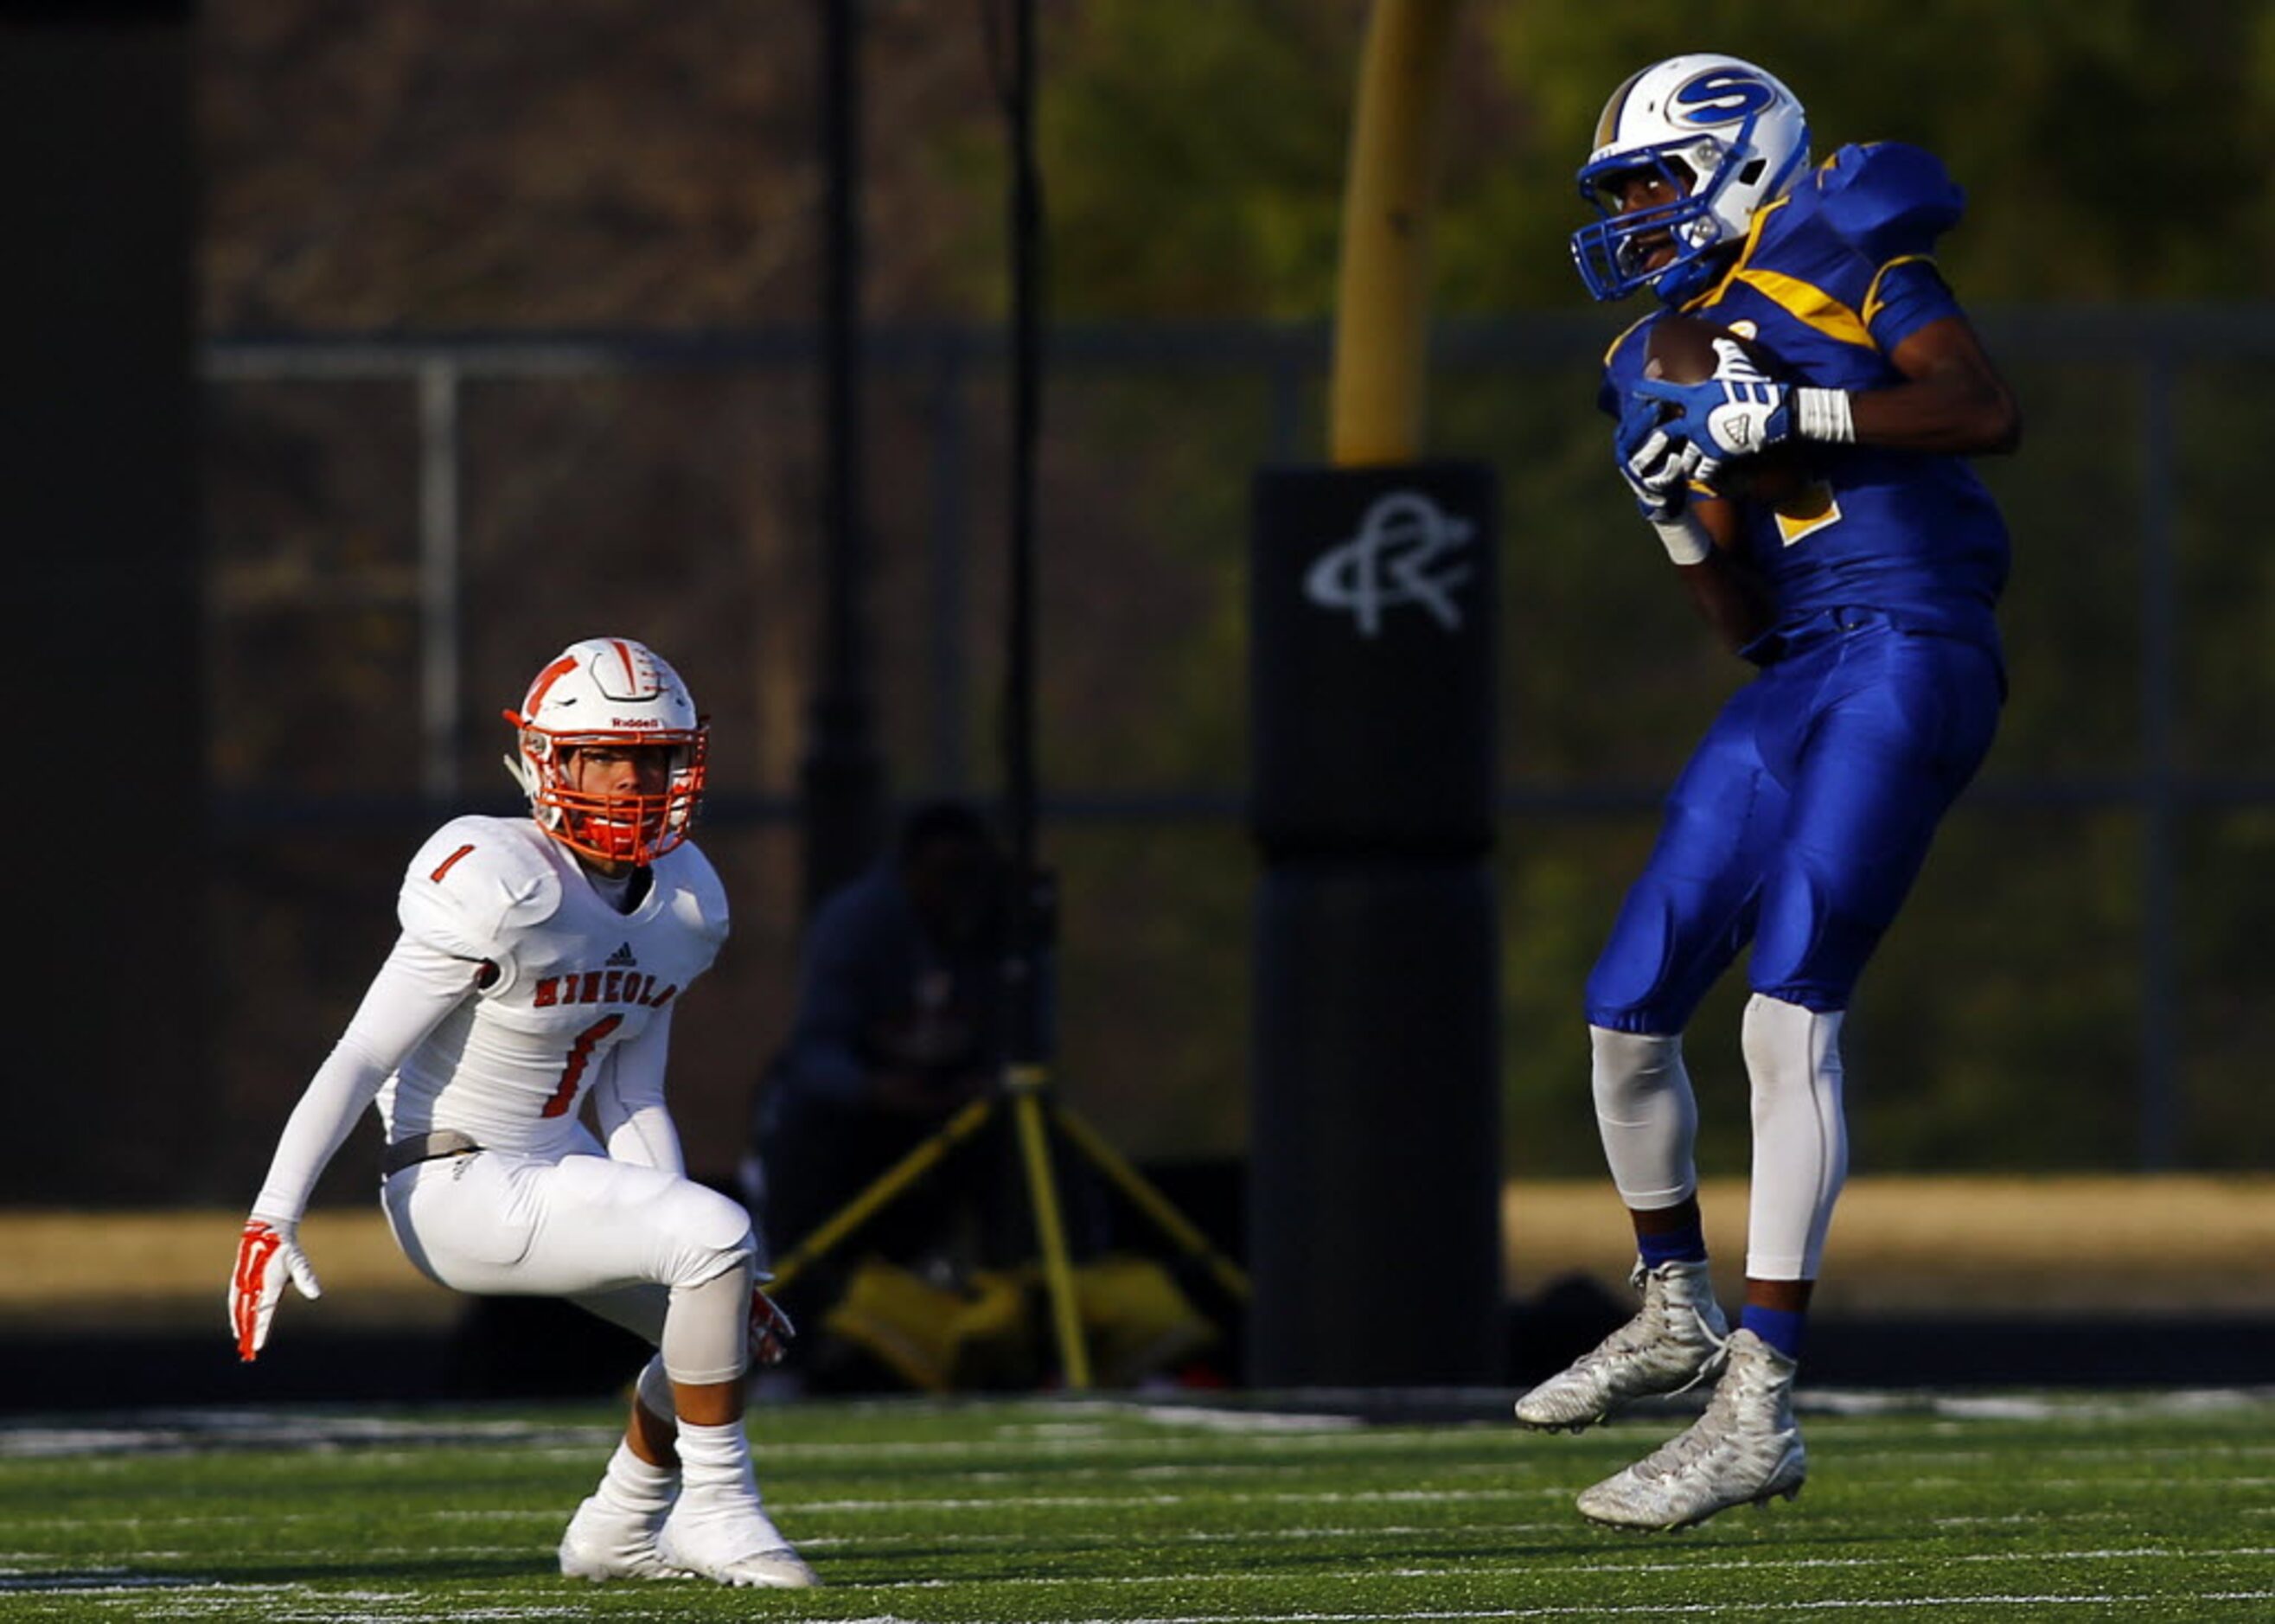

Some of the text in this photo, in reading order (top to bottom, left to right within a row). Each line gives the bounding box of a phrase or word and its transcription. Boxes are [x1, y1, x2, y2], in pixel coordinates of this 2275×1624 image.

[1676, 68, 1773, 123] S
[430, 843, 476, 884] 1
[540, 1013, 625, 1118] 1
